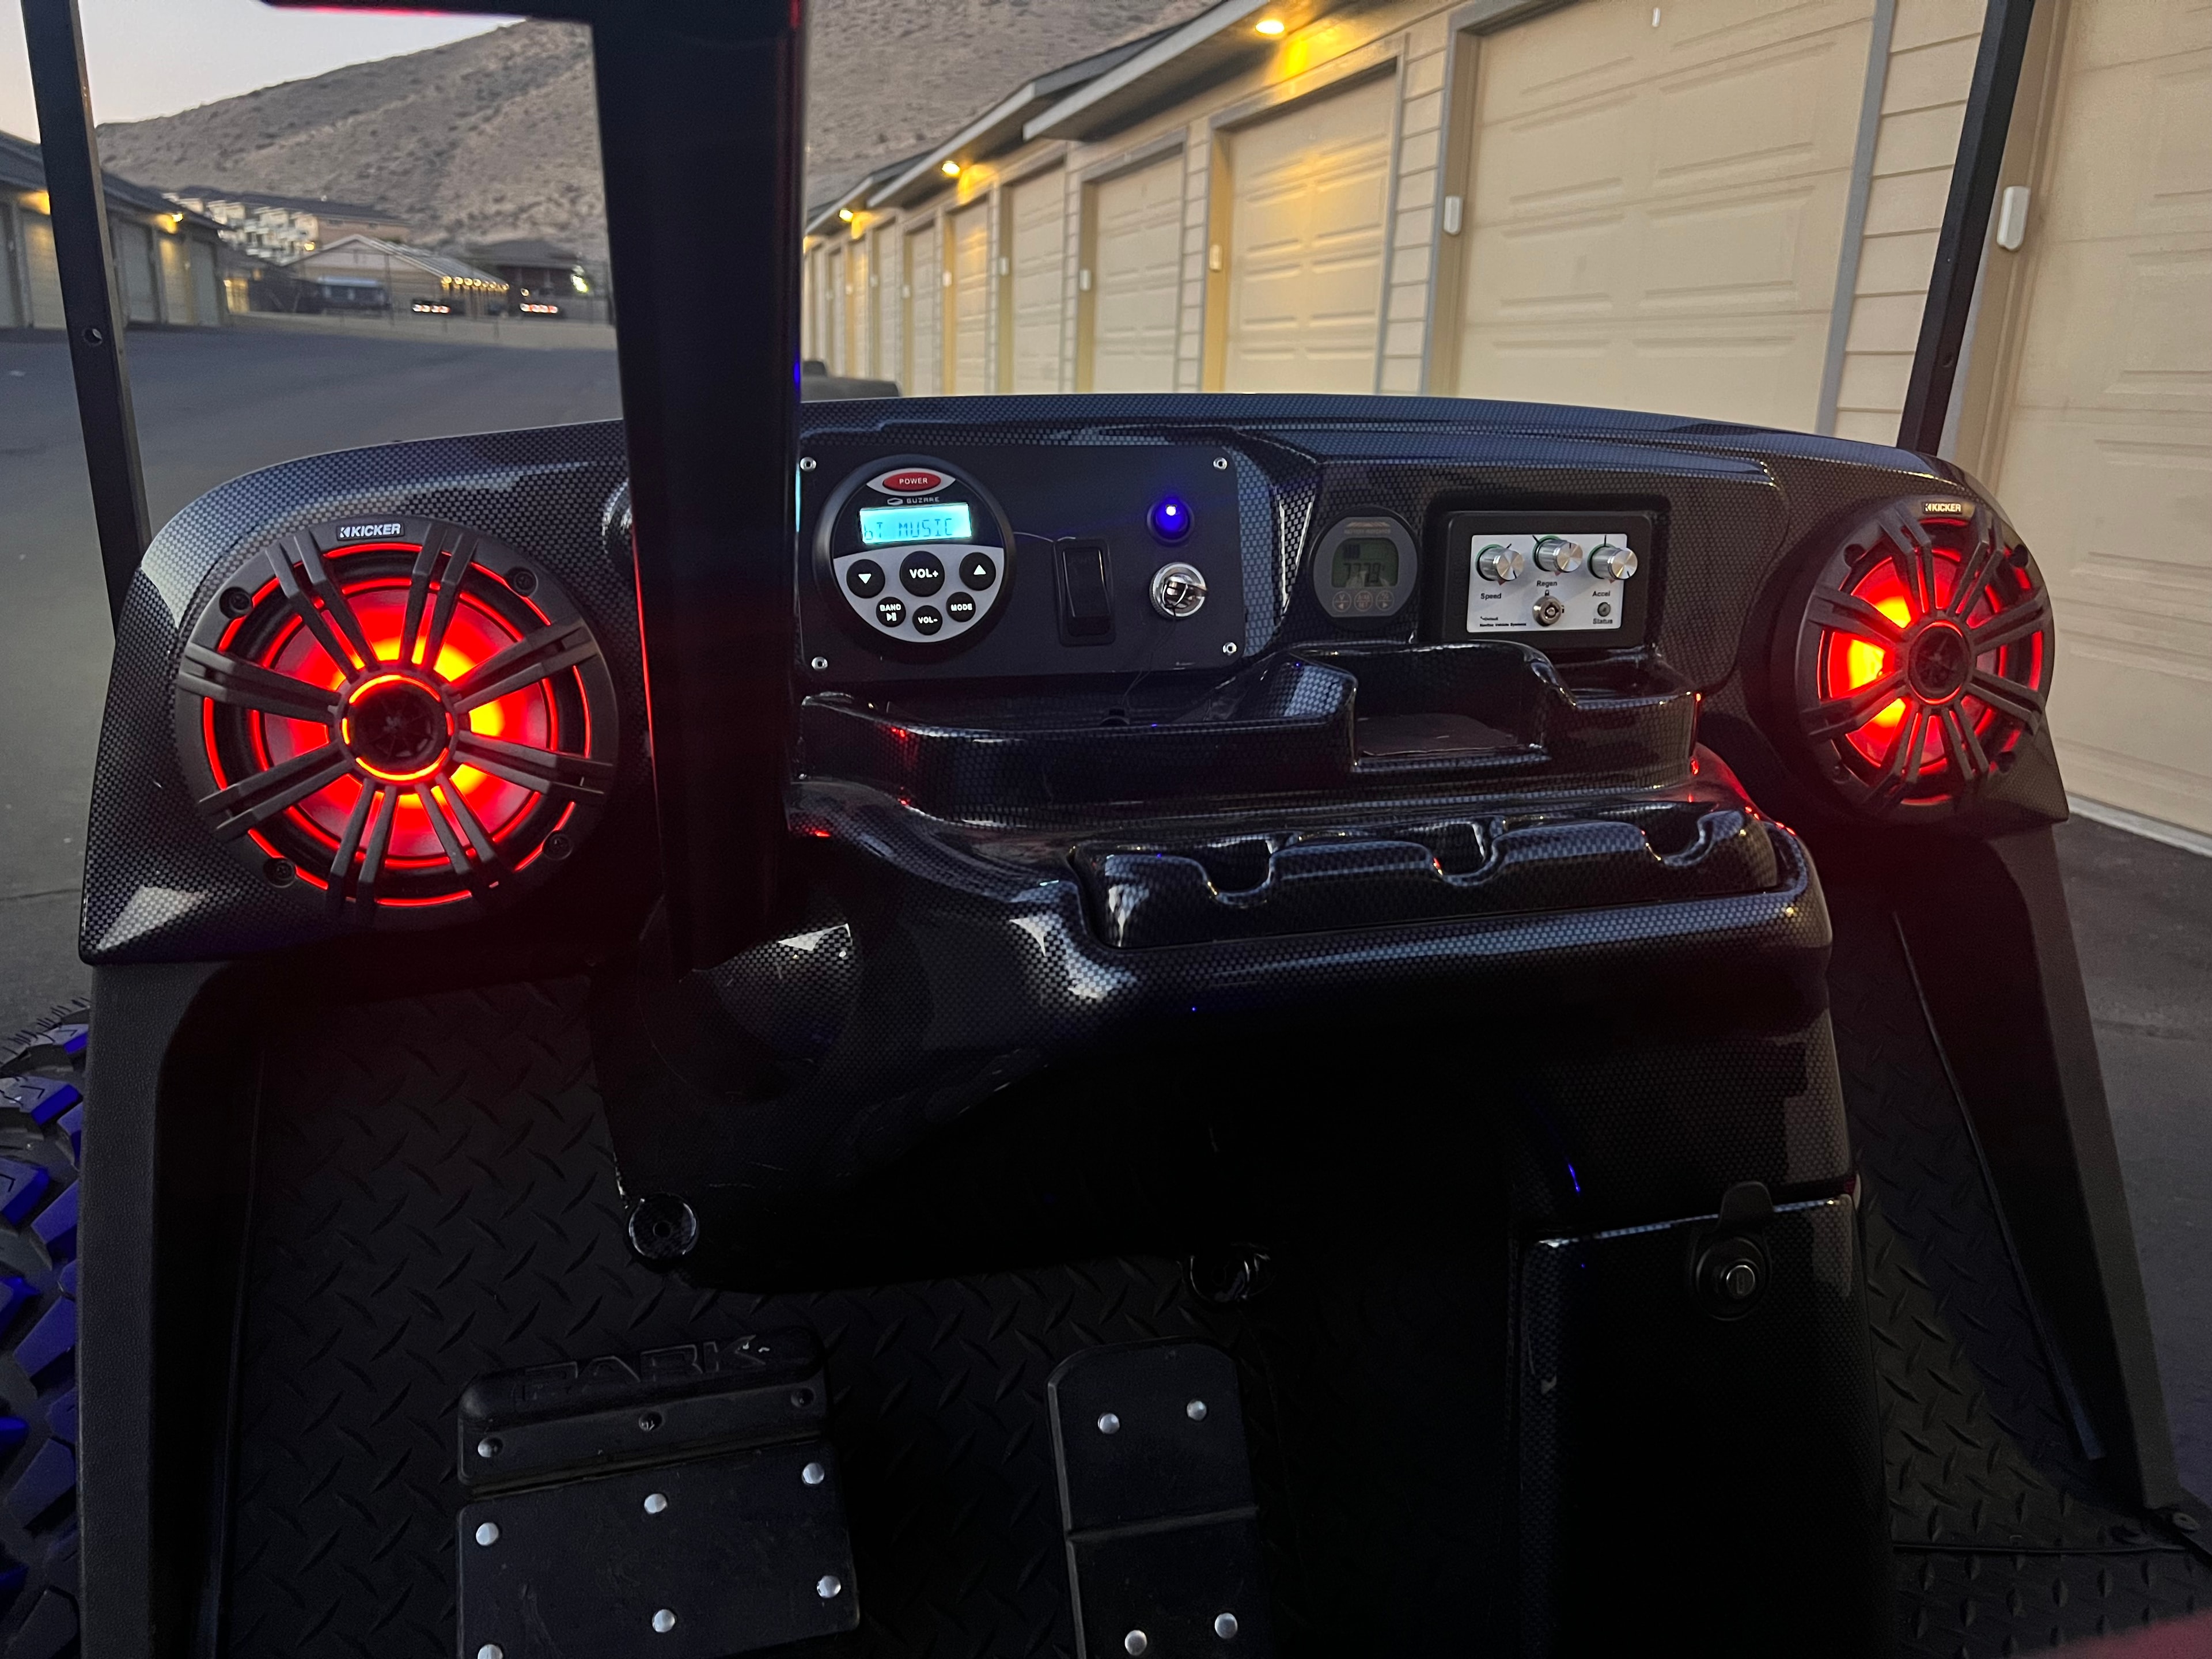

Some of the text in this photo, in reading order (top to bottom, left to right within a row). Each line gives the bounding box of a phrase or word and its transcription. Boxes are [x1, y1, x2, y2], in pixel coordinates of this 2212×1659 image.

[1931, 503, 1961, 512] KICKER
[350, 522, 402, 537] KICKER
[898, 518, 953, 538] MUSIC
[909, 568, 939, 579] VOL+
[1536, 580, 1558, 588] Regen
[1480, 593, 1502, 601] Speed
[879, 603, 902, 612] BAND
[950, 603, 973, 611] MODE
[918, 616, 938, 624] VOL-
[517, 1334, 767, 1400] PARK
